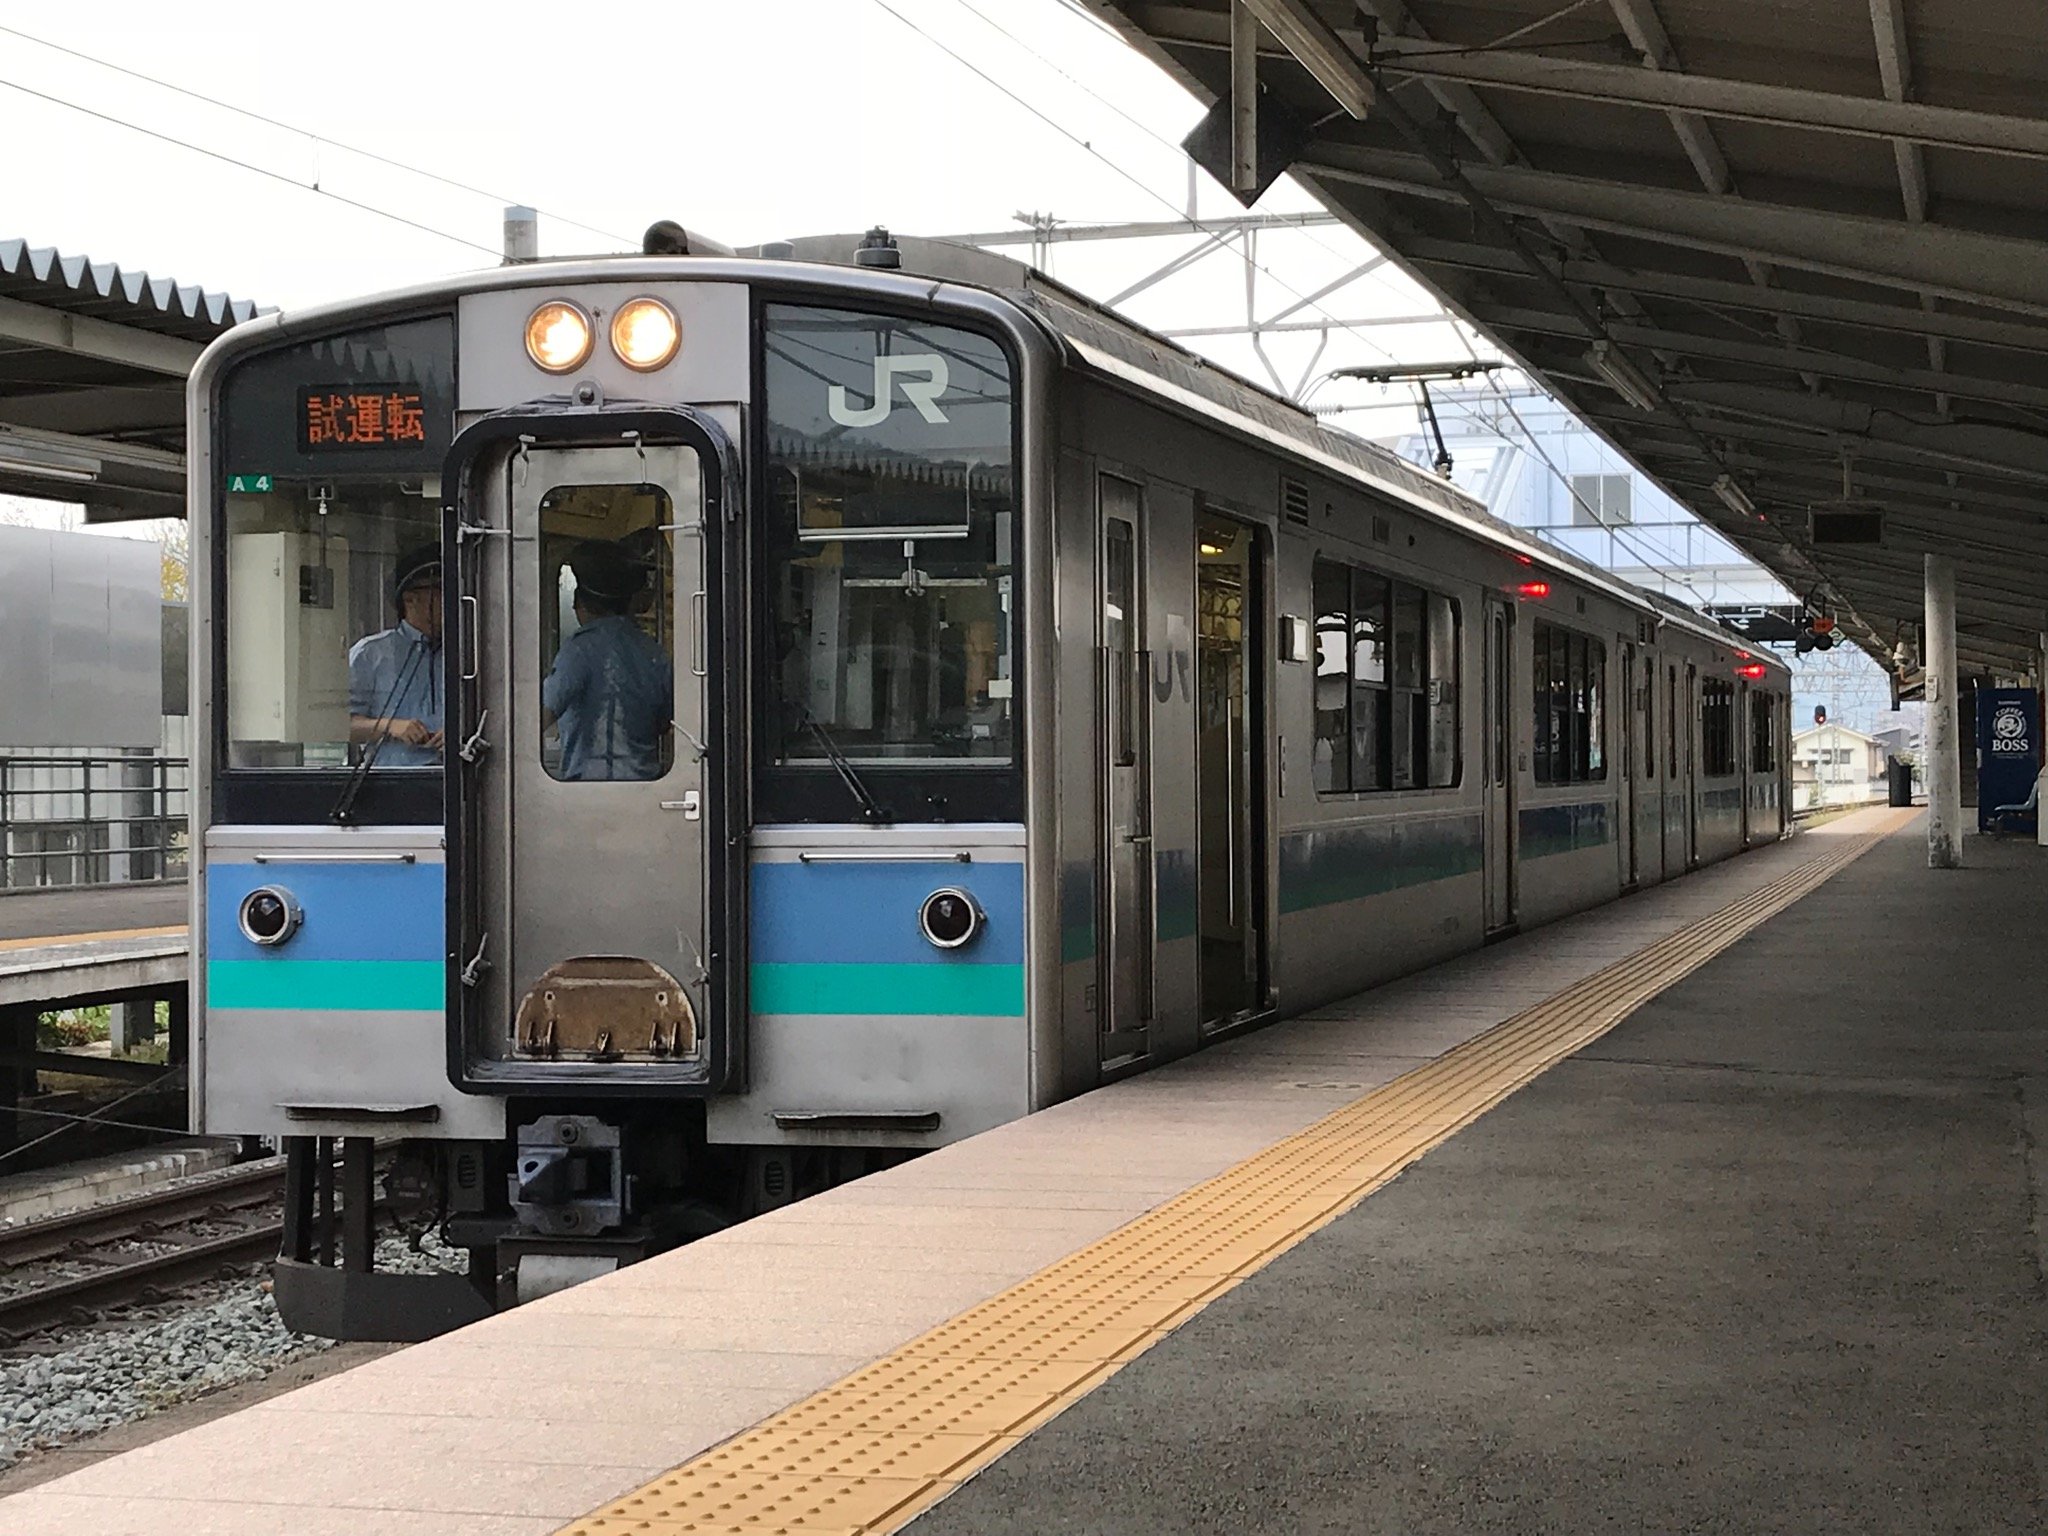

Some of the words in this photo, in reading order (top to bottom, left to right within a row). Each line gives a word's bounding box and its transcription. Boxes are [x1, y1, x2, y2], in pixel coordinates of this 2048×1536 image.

[829, 354, 949, 427] JR
[307, 393, 424, 443] 試運転
[1992, 739, 2028, 751] BOSS
